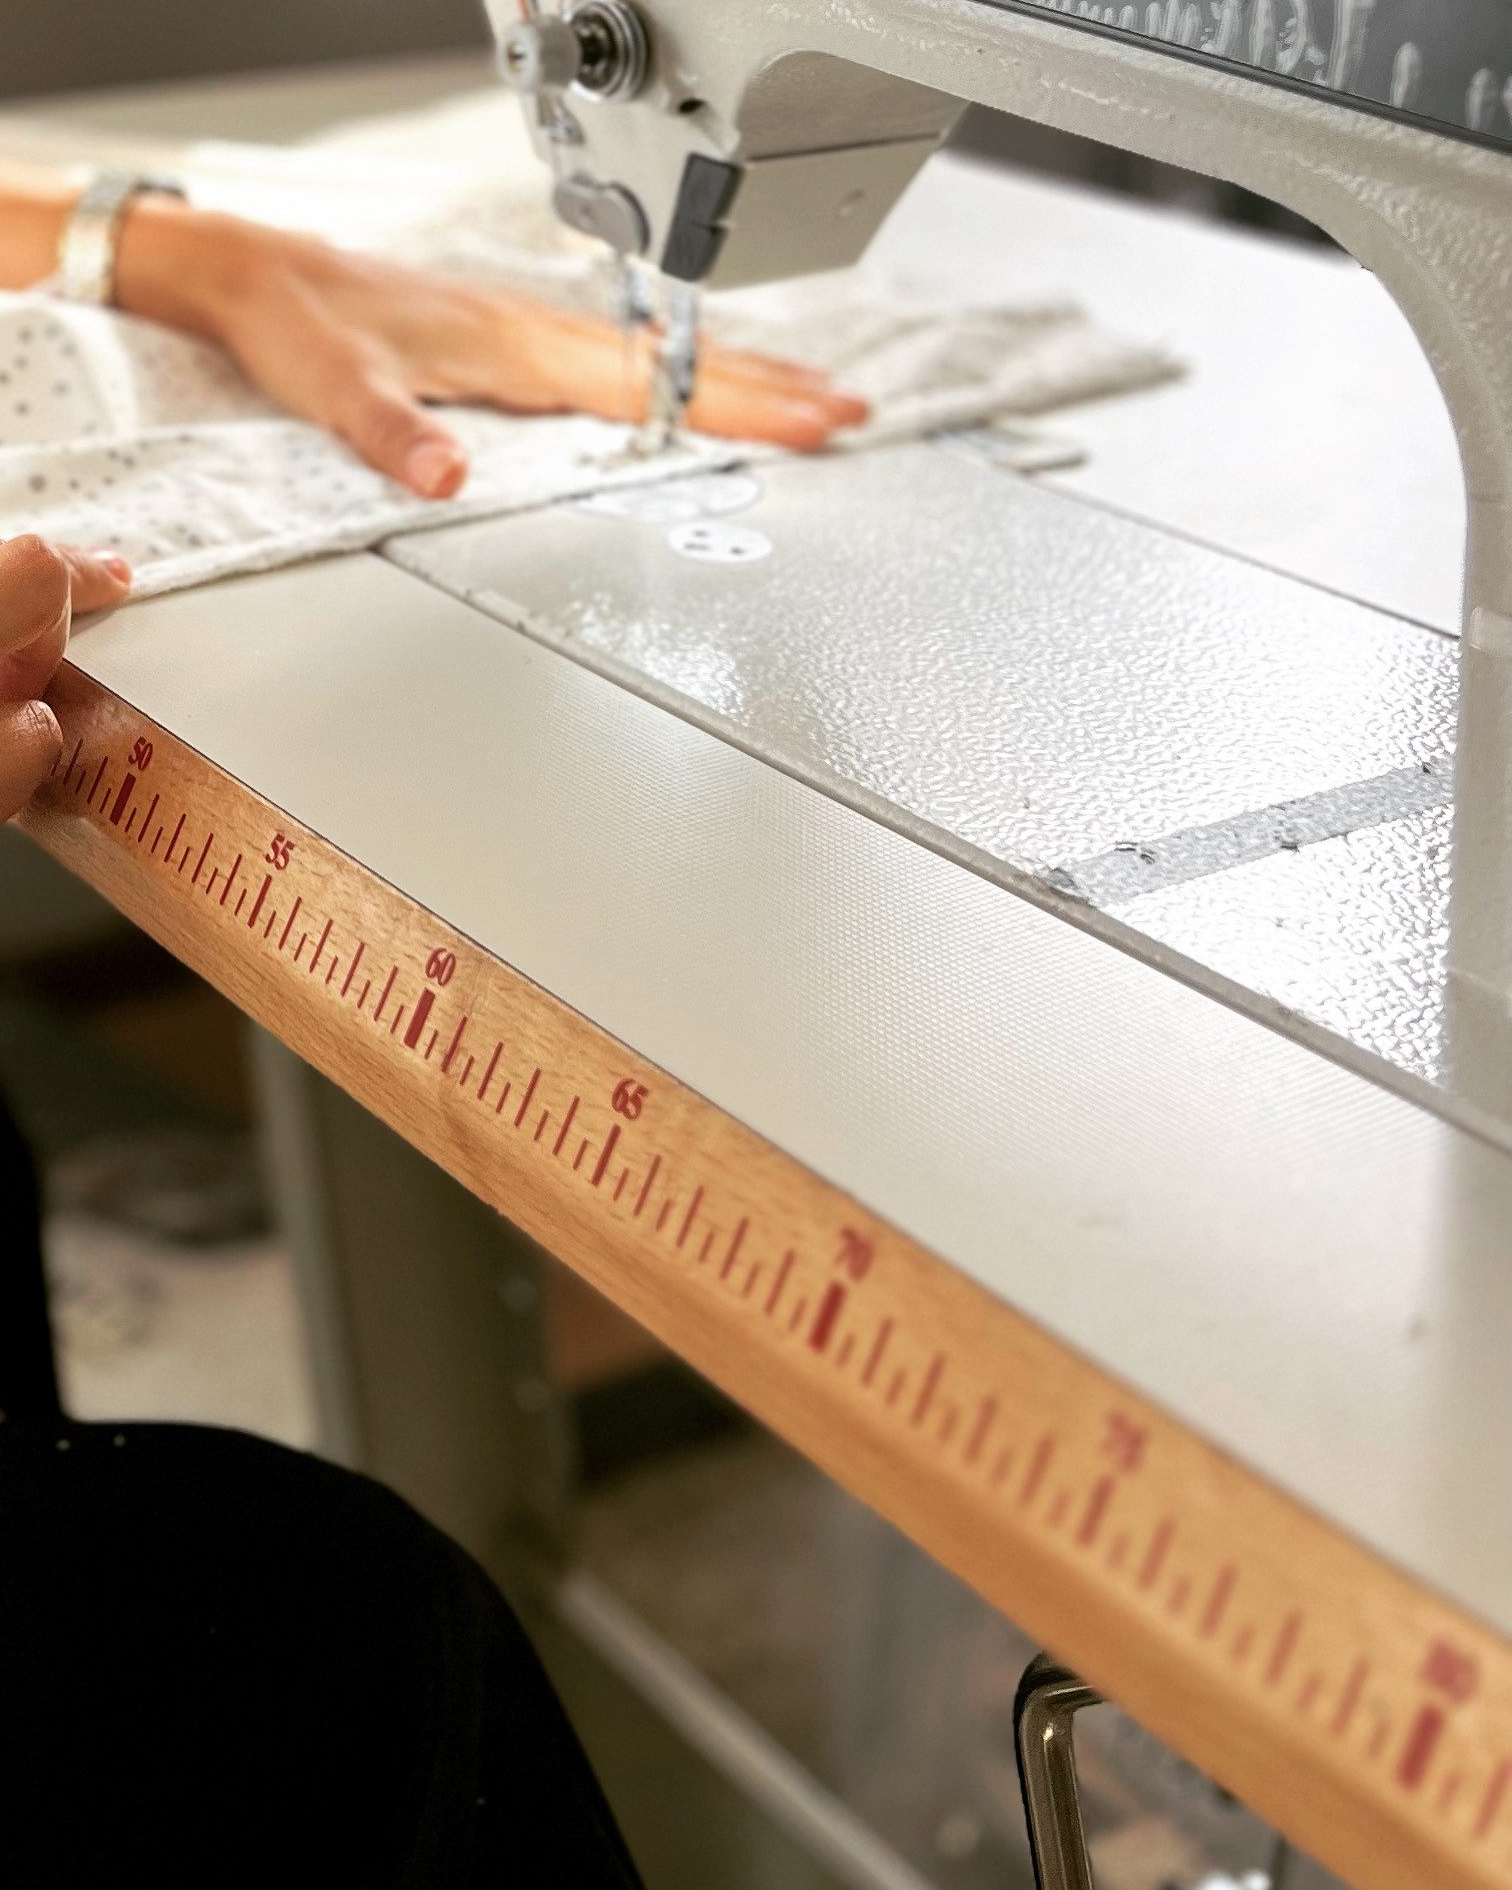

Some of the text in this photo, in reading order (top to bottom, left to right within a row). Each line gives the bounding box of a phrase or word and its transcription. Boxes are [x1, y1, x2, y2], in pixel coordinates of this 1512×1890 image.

[128, 736, 154, 771] 50
[265, 832, 297, 870] 55
[425, 946, 457, 987] 60
[611, 1077, 650, 1122] 65
[836, 1226, 875, 1282] 70
